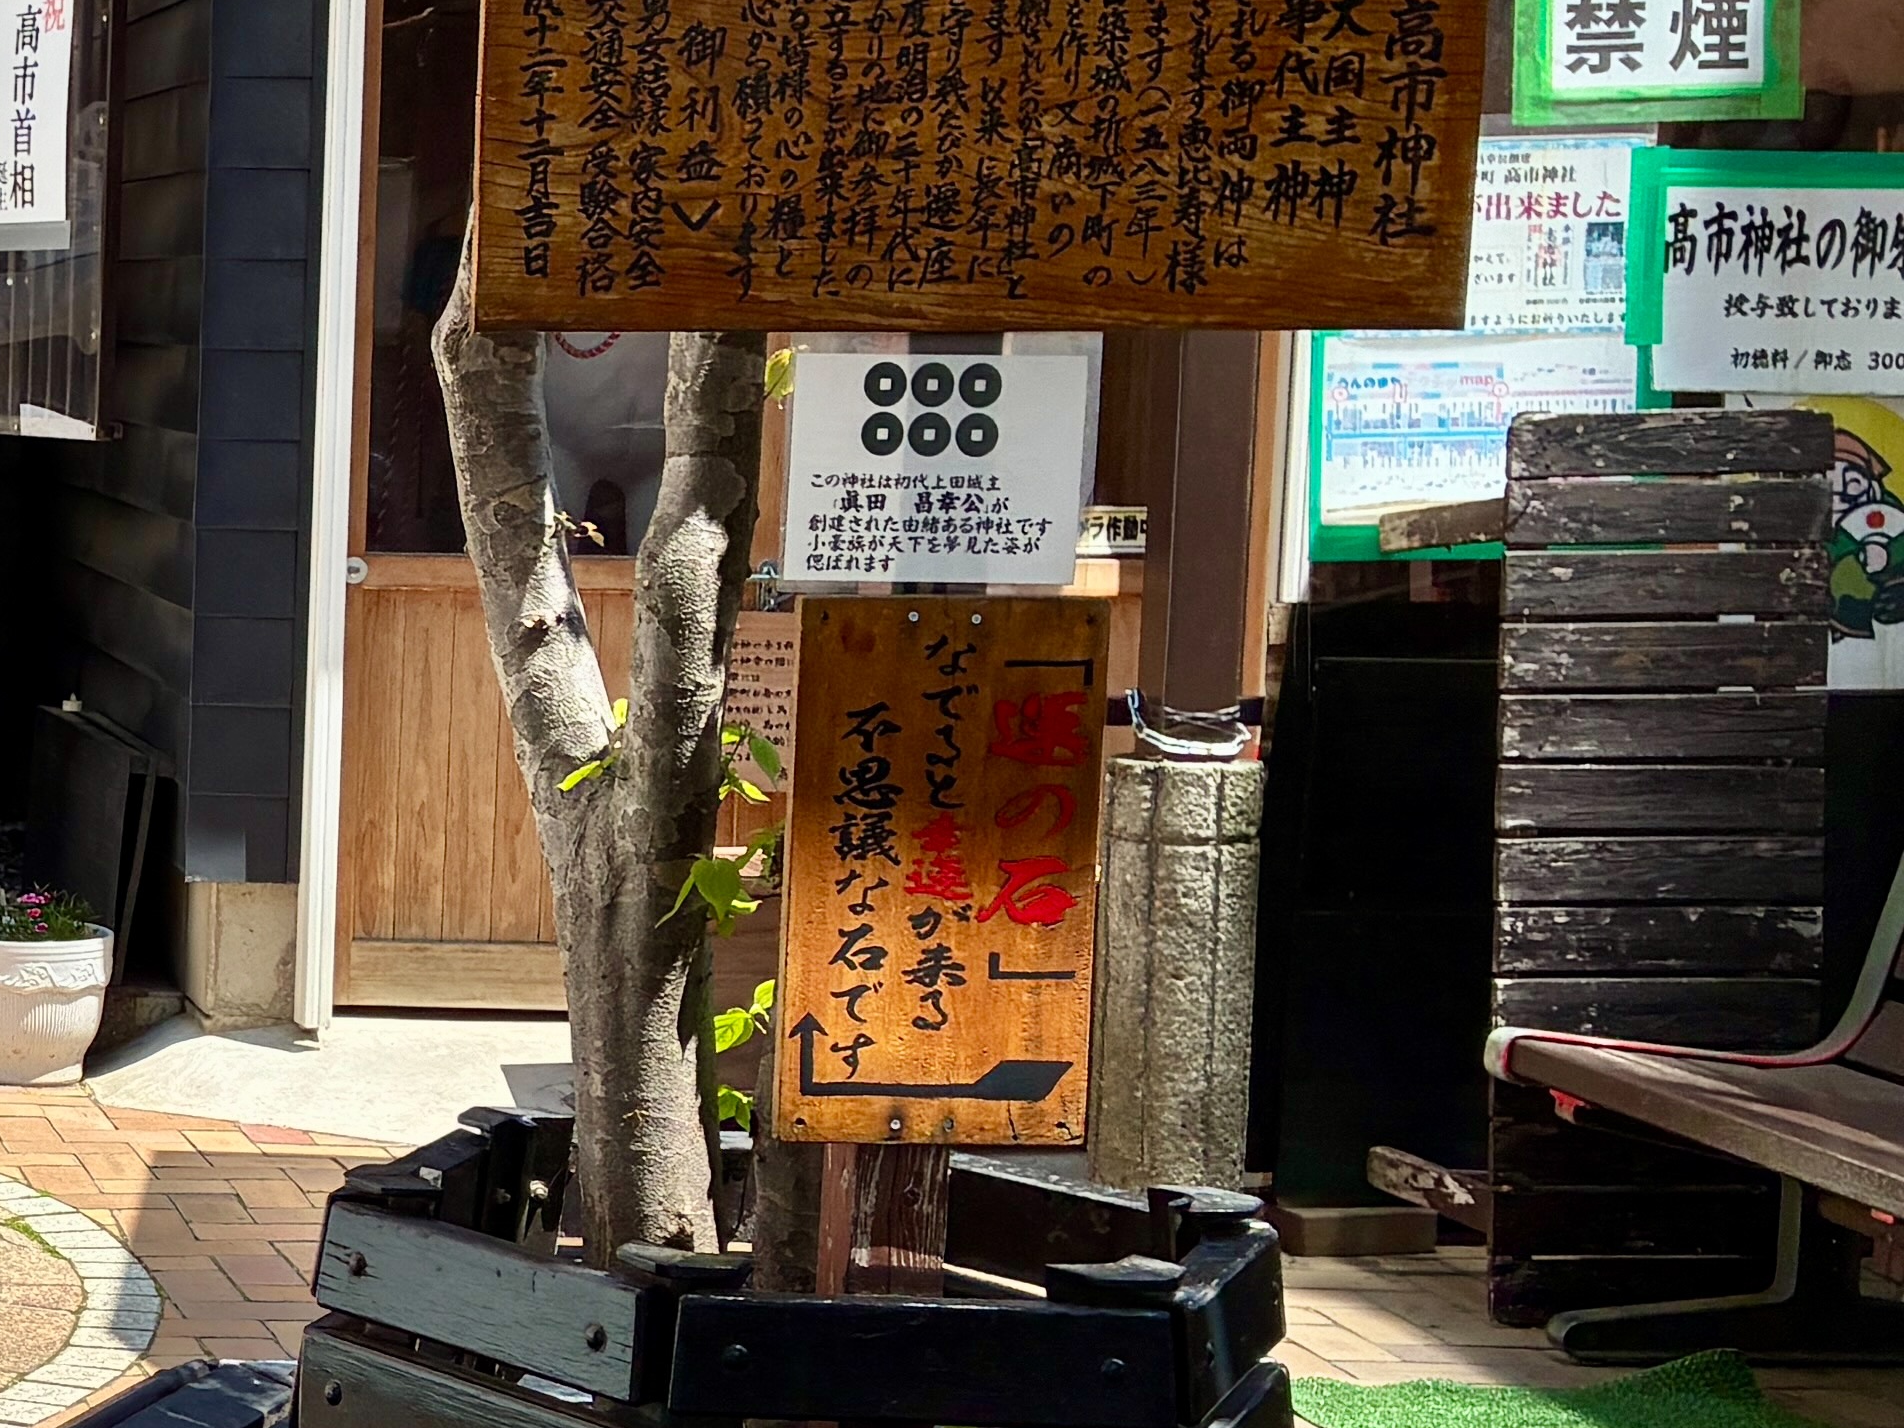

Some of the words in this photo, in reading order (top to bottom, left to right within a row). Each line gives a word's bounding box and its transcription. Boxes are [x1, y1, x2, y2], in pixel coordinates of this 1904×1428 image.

[9, 4, 44, 209] 高市首相
[809, 472, 1002, 492] この神社は初代上田城主
[807, 513, 1054, 537] 創建された由緒ある神社です
[807, 534, 1041, 555] 小豪族が天下を夢見た姿が
[806, 553, 896, 573] 偲ばれます
[901, 632, 979, 1032] なでると幸運が来る
[828, 700, 905, 1080] 不思議な石です
